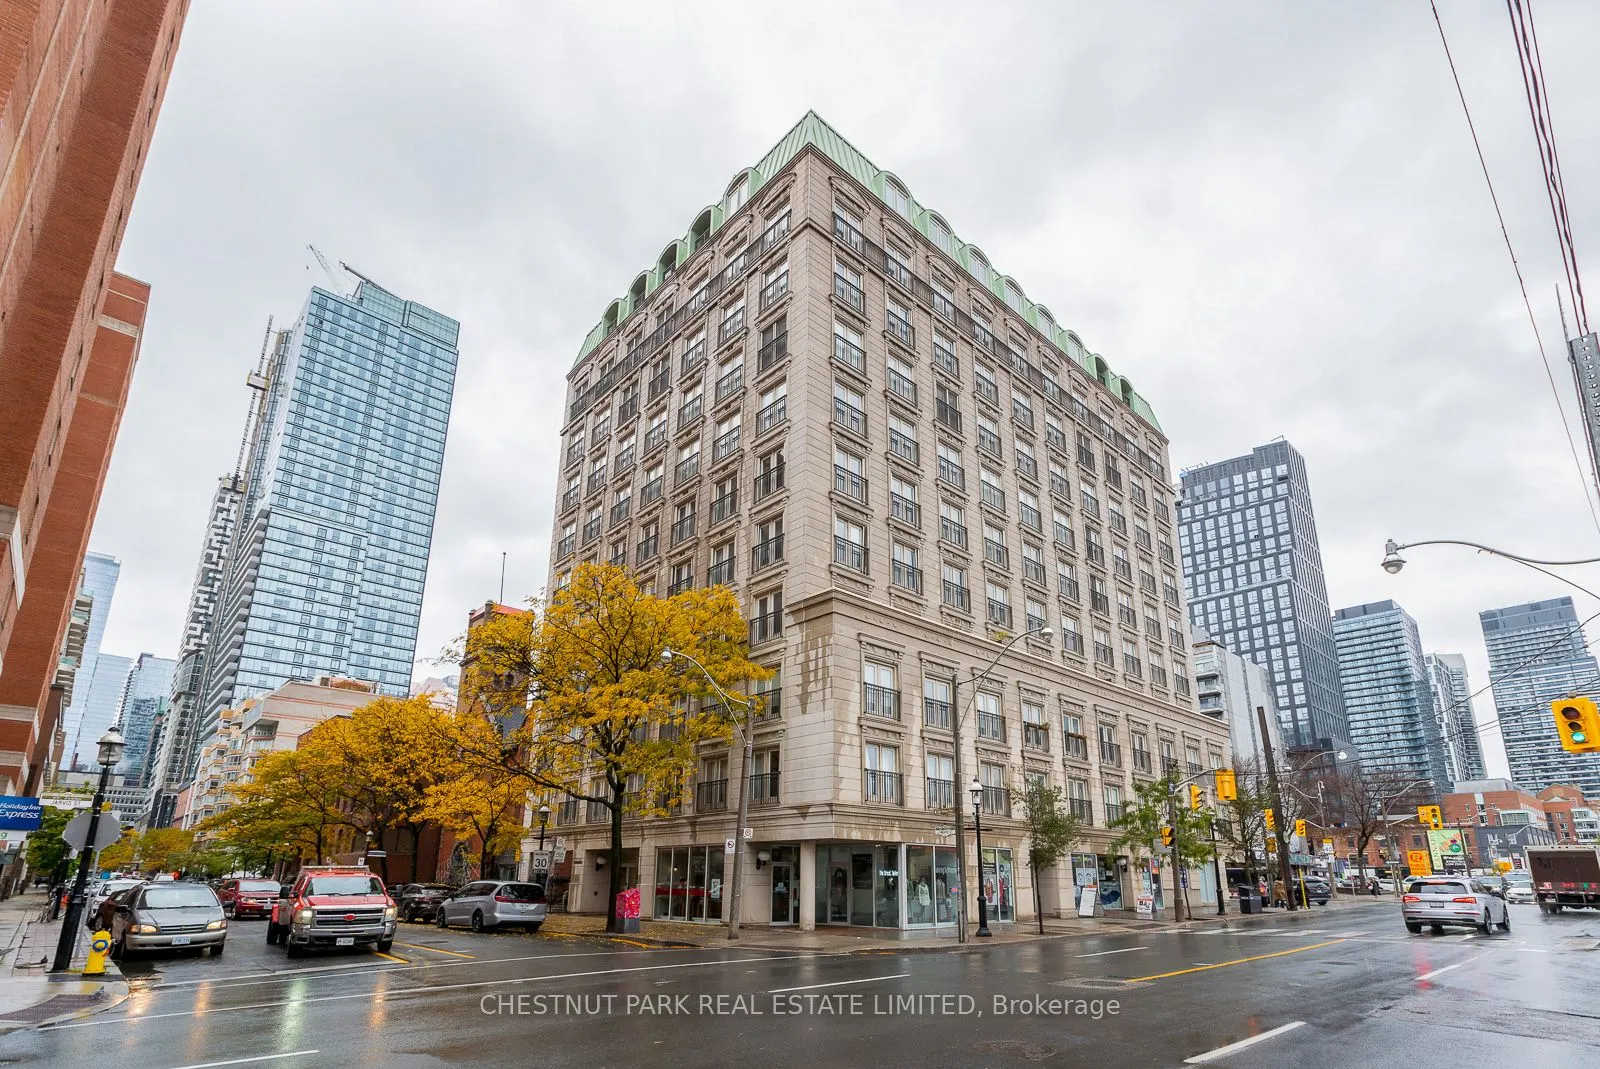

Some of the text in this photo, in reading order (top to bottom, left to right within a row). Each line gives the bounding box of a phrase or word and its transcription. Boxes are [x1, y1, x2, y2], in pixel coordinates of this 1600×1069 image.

[0, 803, 29, 811] Holiday
[0, 809, 39, 819] Express
[535, 859, 547, 868] 30
